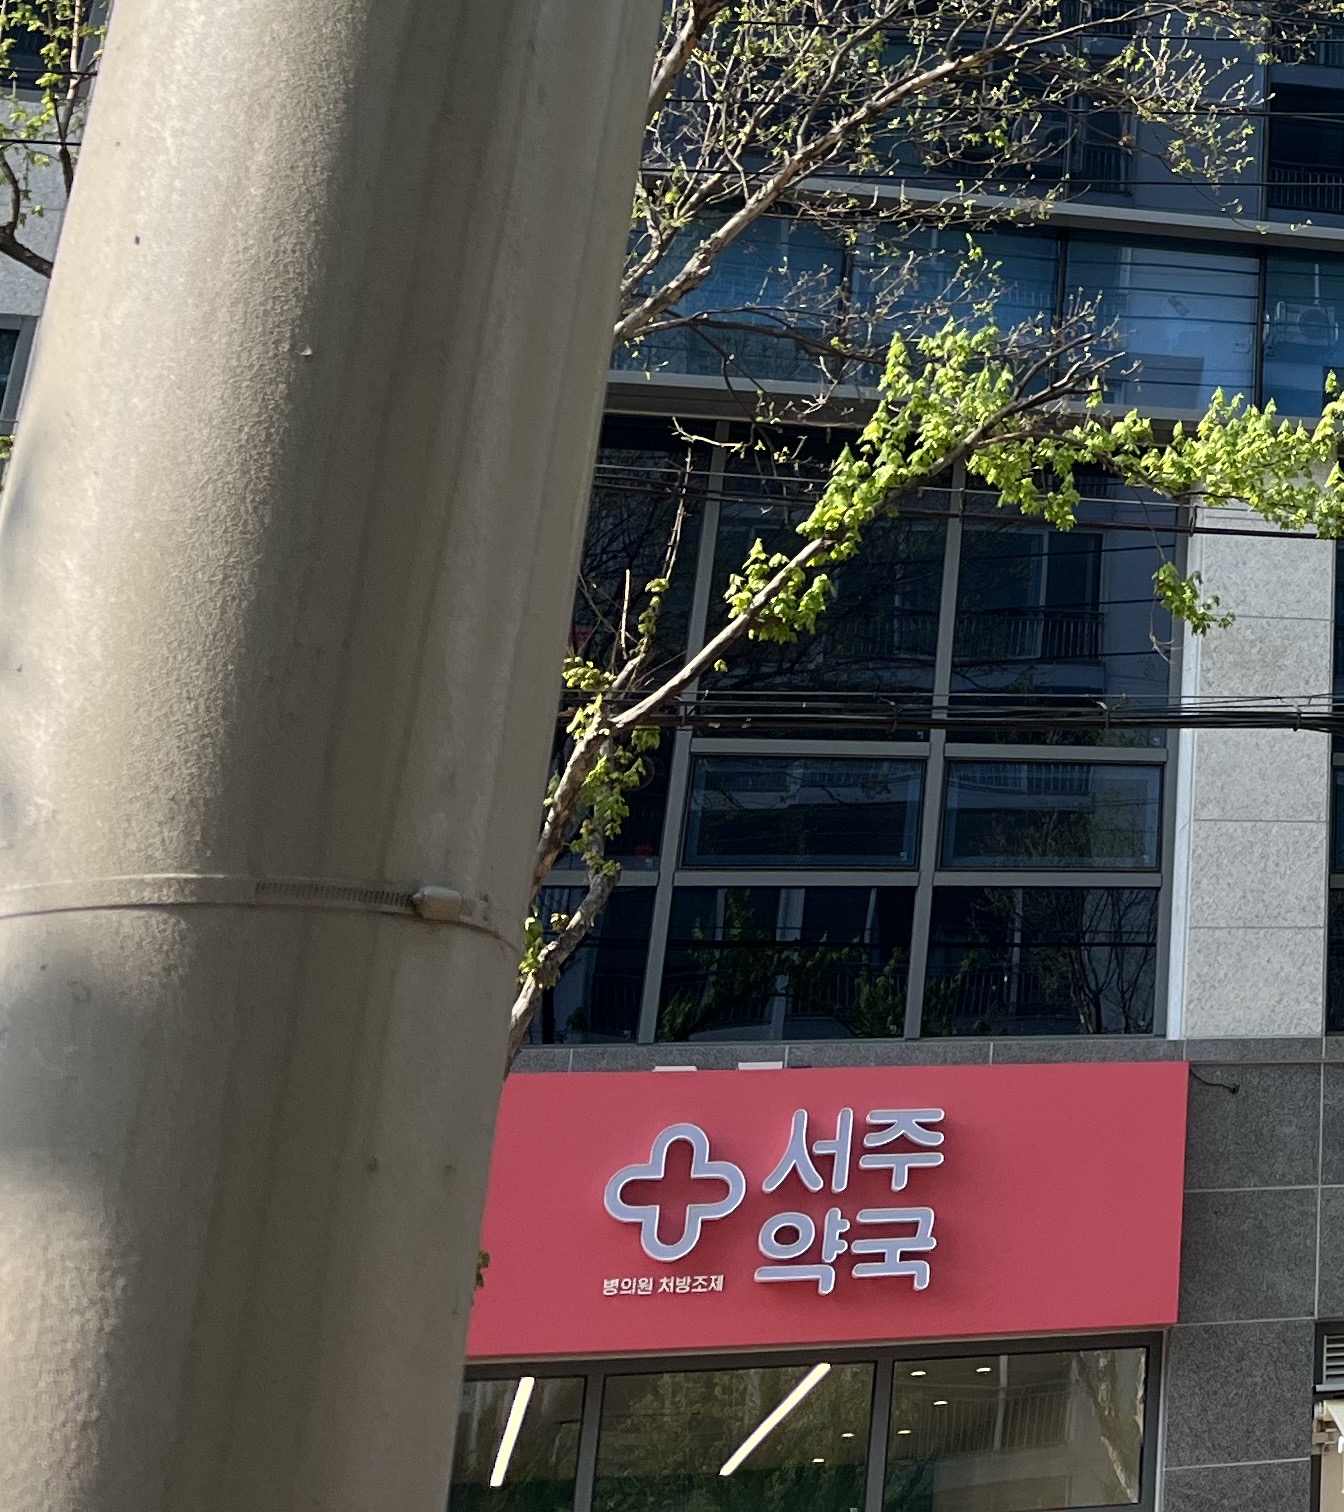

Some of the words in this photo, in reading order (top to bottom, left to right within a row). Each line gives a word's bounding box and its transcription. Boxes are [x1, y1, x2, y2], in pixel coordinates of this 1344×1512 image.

[762, 1107, 946, 1192] 서주
[603, 1276, 654, 1296] 병의원
[657, 1274, 725, 1294] 처방조제
[753, 1206, 938, 1295] 약국
